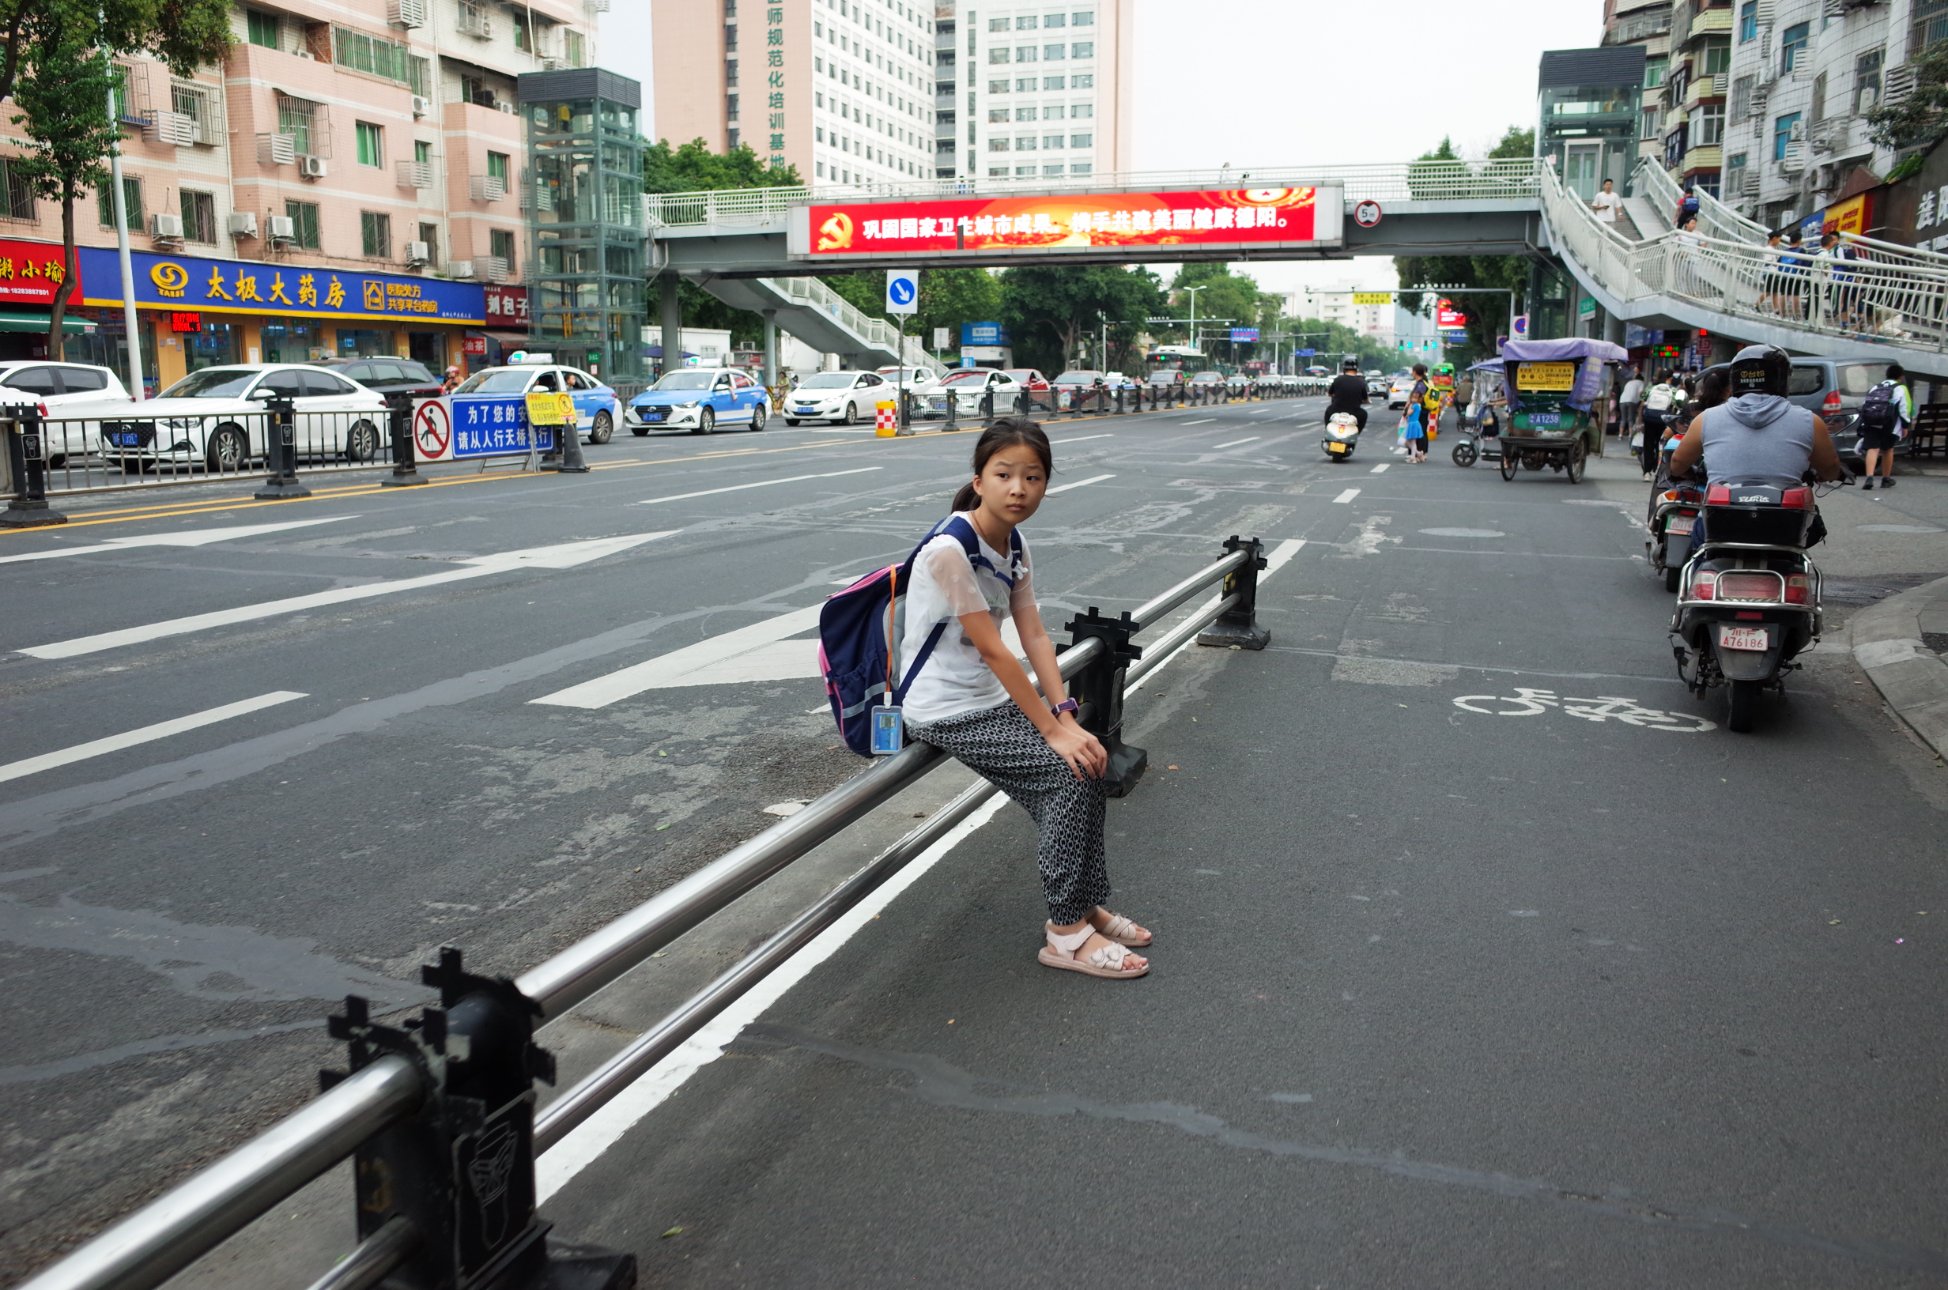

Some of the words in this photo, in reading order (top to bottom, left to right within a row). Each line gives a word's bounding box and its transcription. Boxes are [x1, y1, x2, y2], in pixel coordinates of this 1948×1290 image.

[767, 0, 786, 171] 师规范化培训基地
[206, 265, 347, 310] 太极大药房
[1723, 636, 1764, 648] A76186
